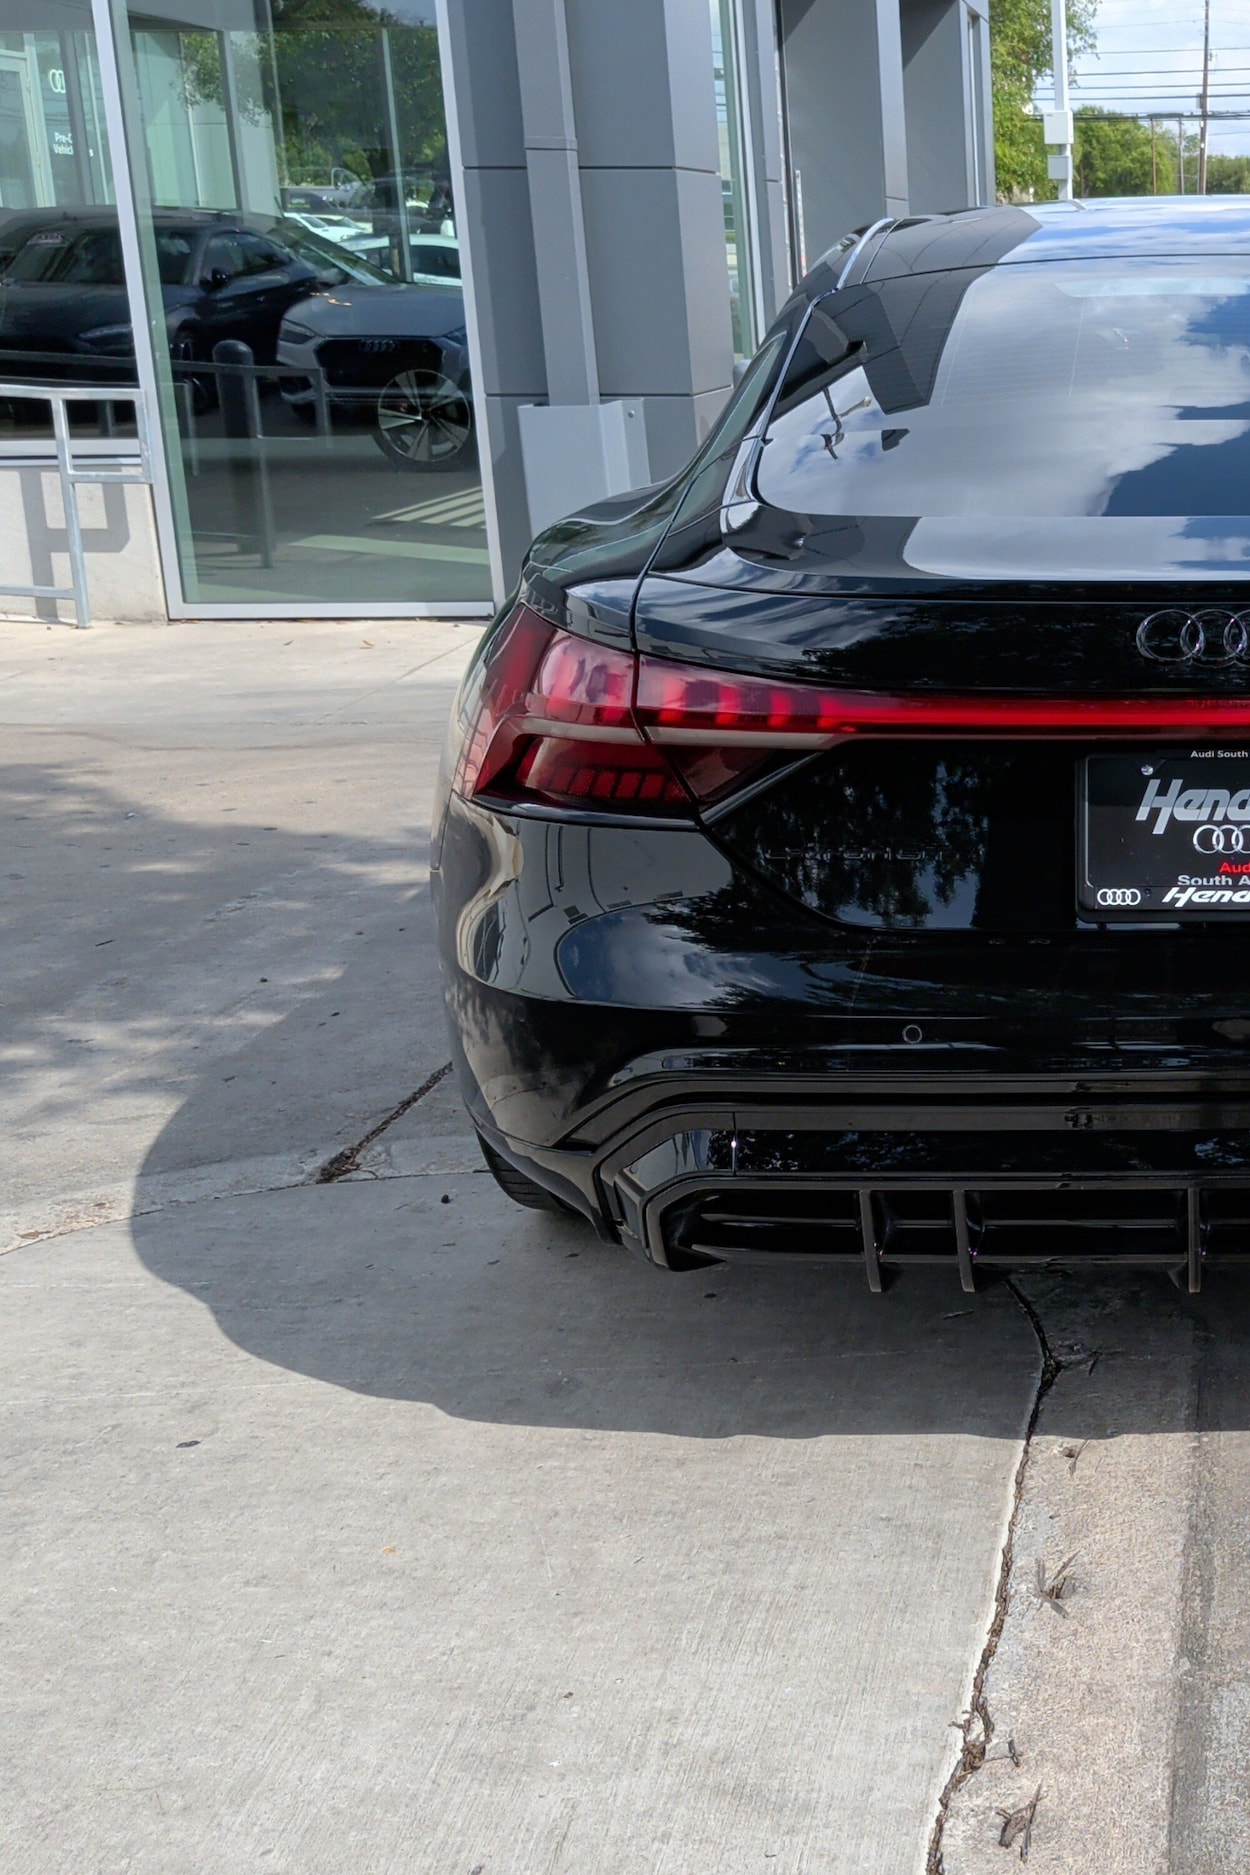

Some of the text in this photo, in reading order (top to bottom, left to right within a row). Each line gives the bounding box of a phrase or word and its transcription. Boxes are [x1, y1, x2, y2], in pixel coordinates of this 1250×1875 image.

[1190, 750, 1215, 758] Audi
[1217, 750, 1249, 758] South
[1177, 874, 1233, 886] South
